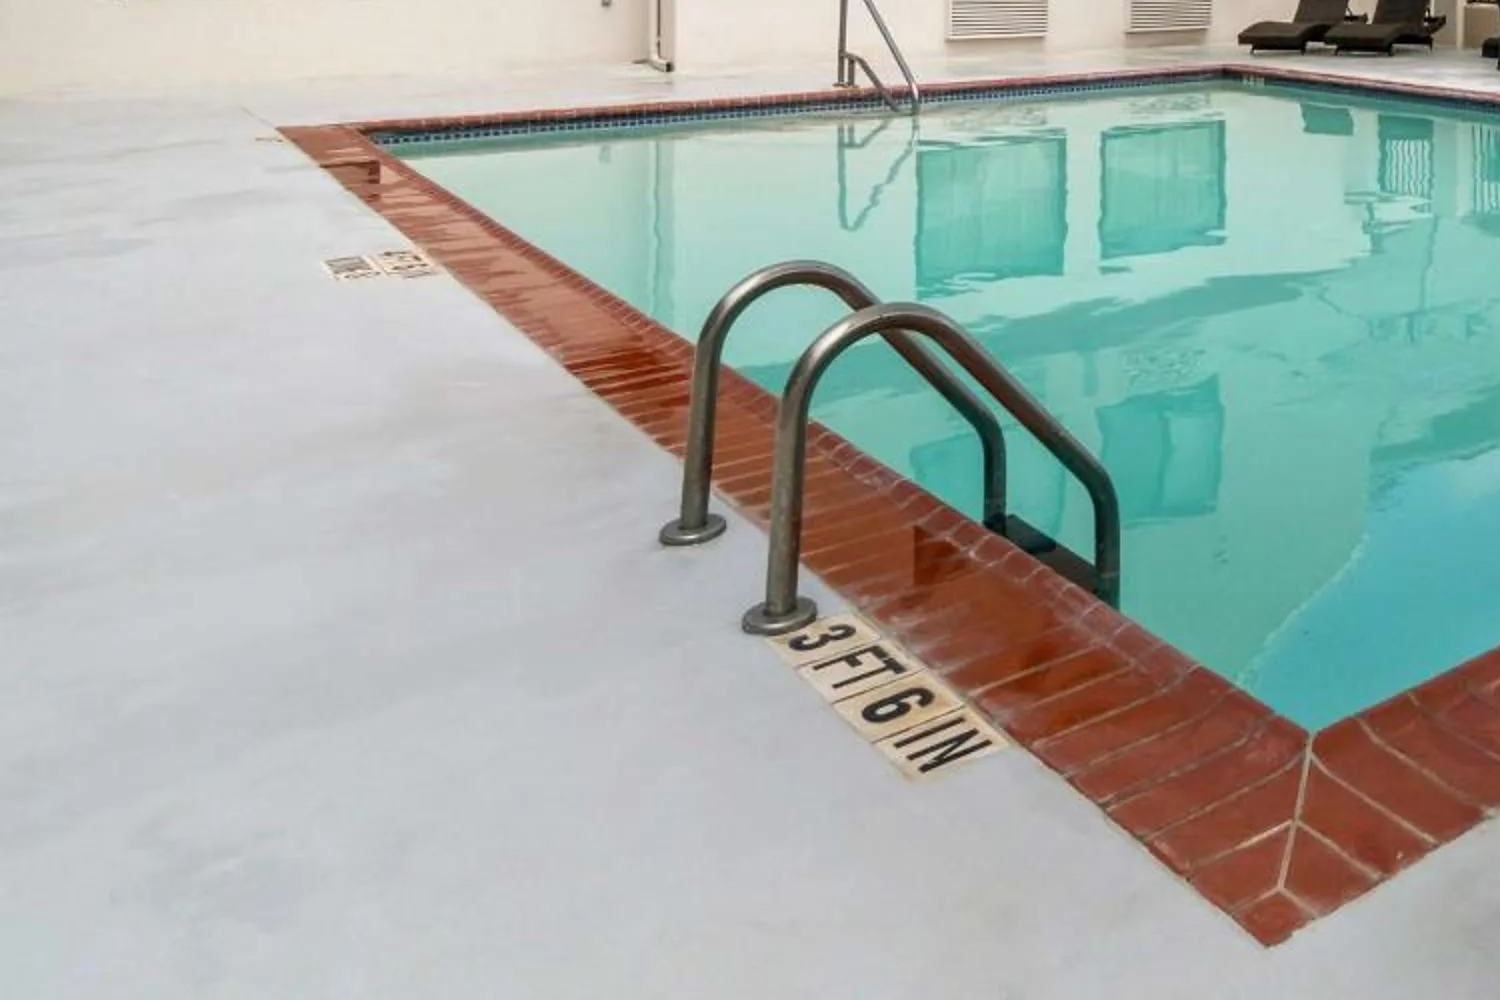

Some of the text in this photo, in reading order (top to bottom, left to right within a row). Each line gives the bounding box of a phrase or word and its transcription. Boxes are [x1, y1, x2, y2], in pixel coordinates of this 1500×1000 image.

[787, 623, 993, 774] 3 FT 6 IN
